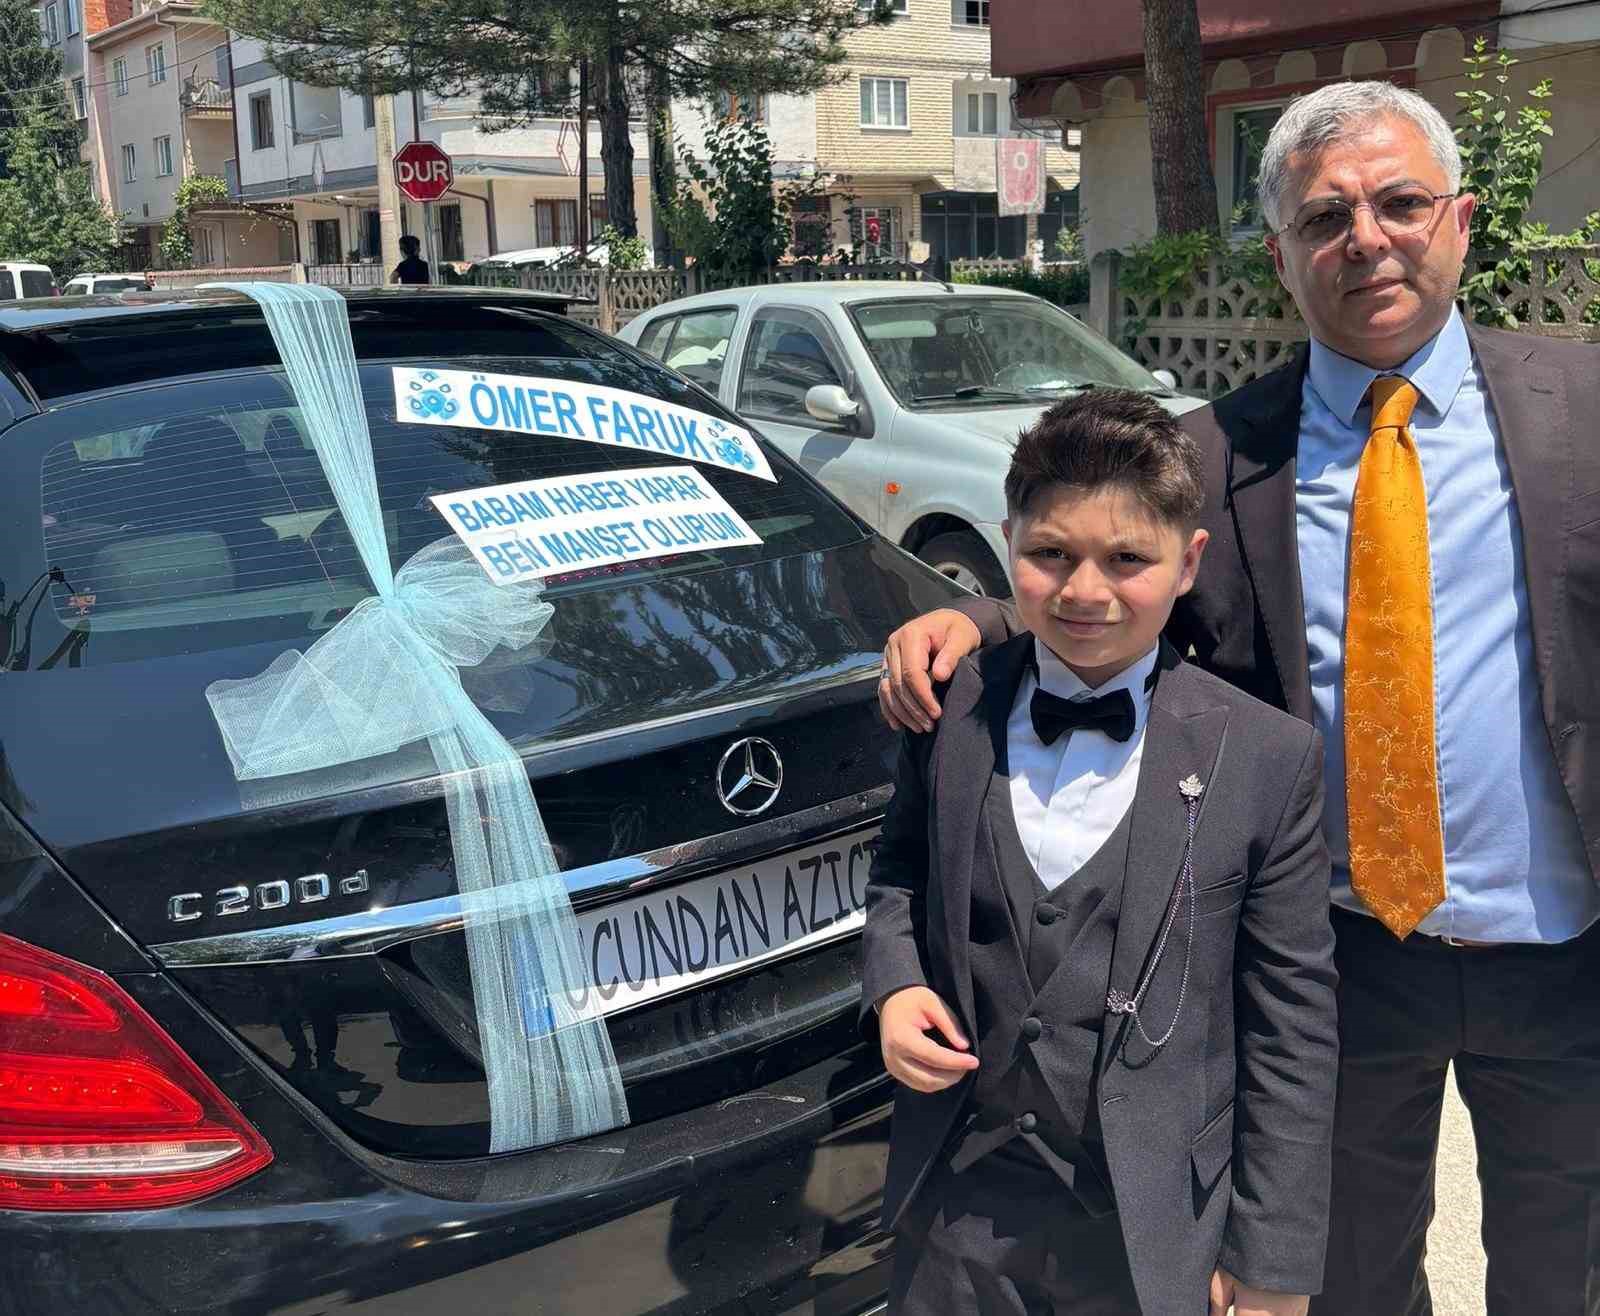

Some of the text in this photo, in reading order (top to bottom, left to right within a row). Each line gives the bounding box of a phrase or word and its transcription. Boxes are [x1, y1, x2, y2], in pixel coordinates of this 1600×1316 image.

[398, 161, 449, 182] DUR
[469, 375, 714, 462] ÖMER FARUK
[450, 474, 711, 532] BABAM HABER YAPAR
[480, 511, 747, 578] BEN MANŞET OLURUM
[168, 893, 203, 923] C
